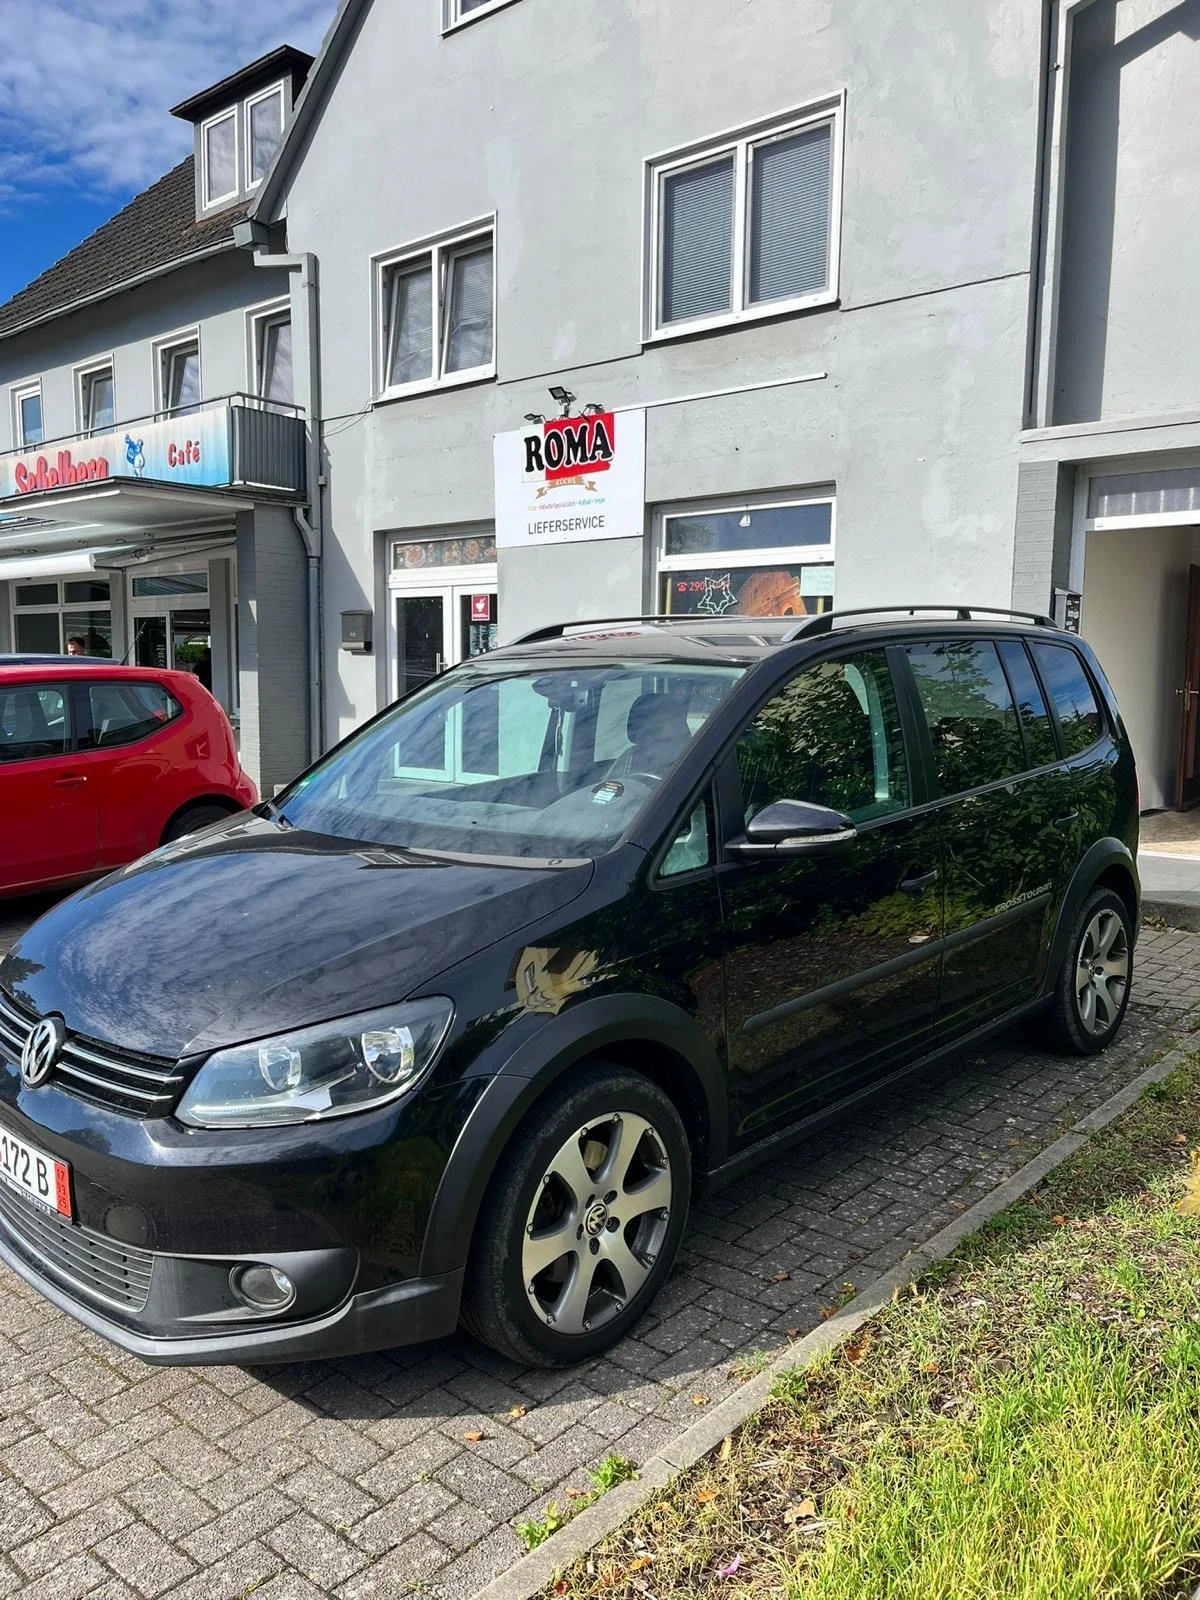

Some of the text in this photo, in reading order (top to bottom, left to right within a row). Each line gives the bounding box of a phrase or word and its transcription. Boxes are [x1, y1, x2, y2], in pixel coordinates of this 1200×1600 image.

[168, 440, 200, 468] Café
[523, 421, 613, 473] ROMA
[528, 515, 605, 535] LIEFERSERVICE
[994, 881, 1052, 914] CROSSTOURAN
[2, 1135, 49, 1197] 172 B
